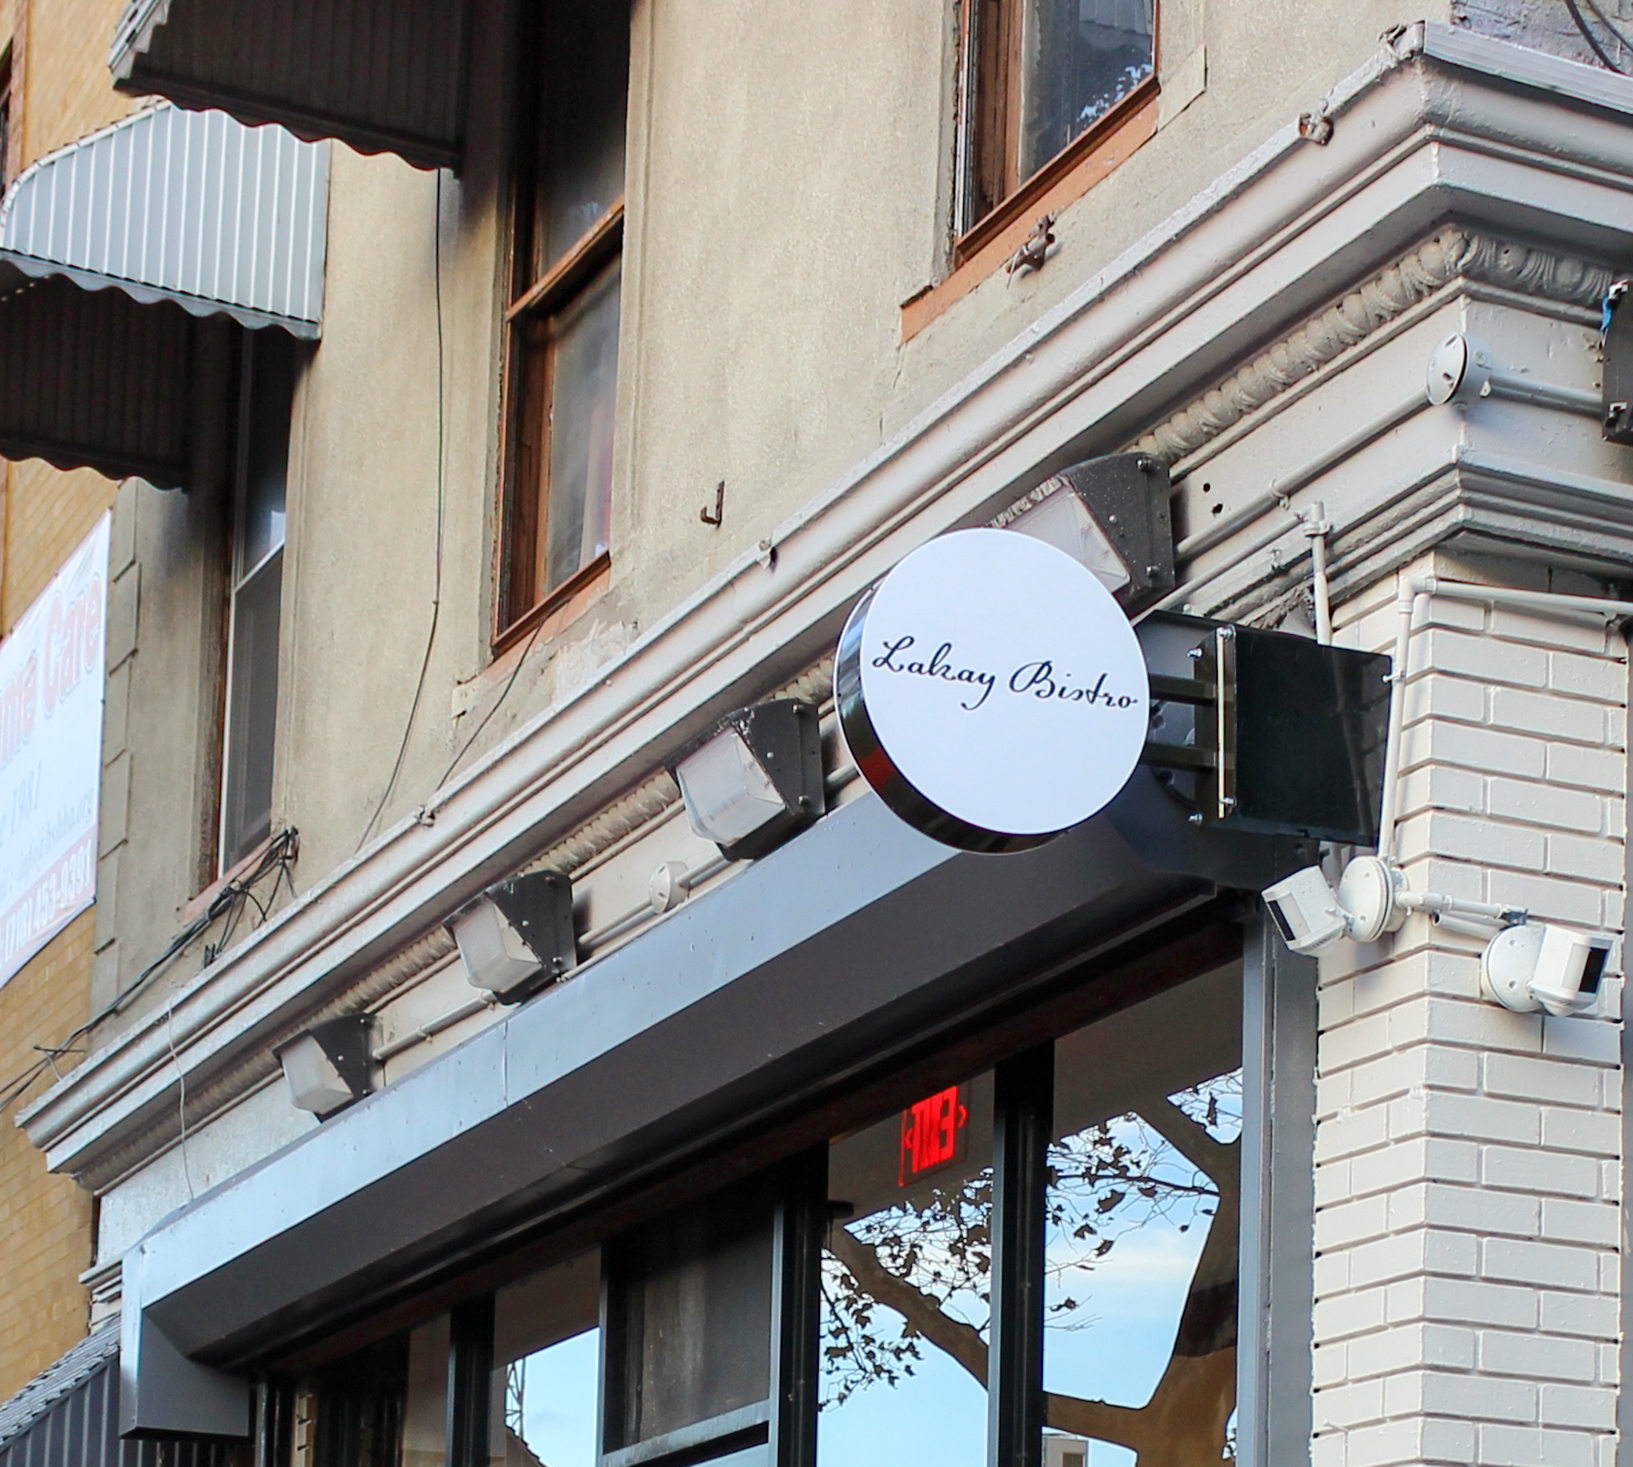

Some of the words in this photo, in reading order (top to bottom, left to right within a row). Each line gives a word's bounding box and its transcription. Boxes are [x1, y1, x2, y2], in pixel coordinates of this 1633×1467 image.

[43, 572, 102, 720] Care
[1007, 660, 1139, 710] Bistro
[10, 761, 41, 835] 1981
[33, 840, 91, 930] 453-9391
